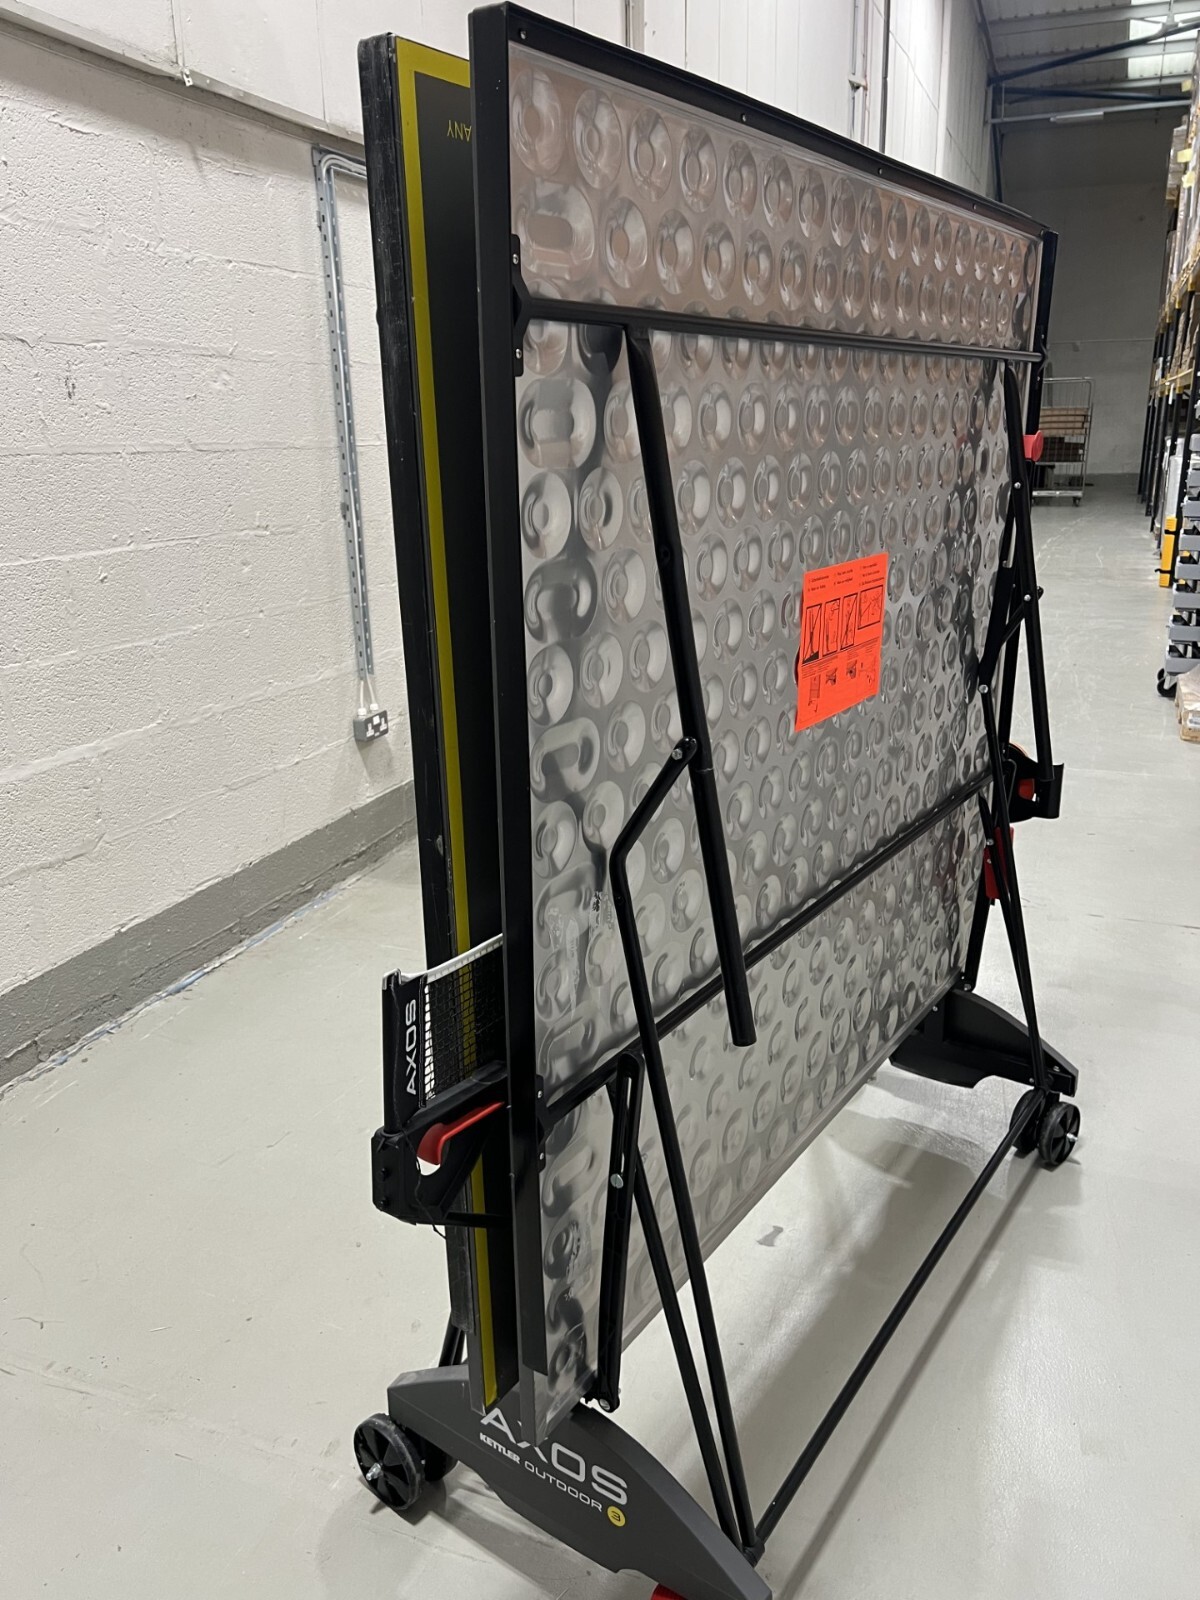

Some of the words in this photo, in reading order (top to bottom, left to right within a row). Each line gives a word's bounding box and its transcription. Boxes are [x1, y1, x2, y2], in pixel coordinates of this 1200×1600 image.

[405, 999, 417, 1096] AXOS
[479, 1432, 521, 1465] KETTLER
[524, 1461, 603, 1513] OUTDOOR
